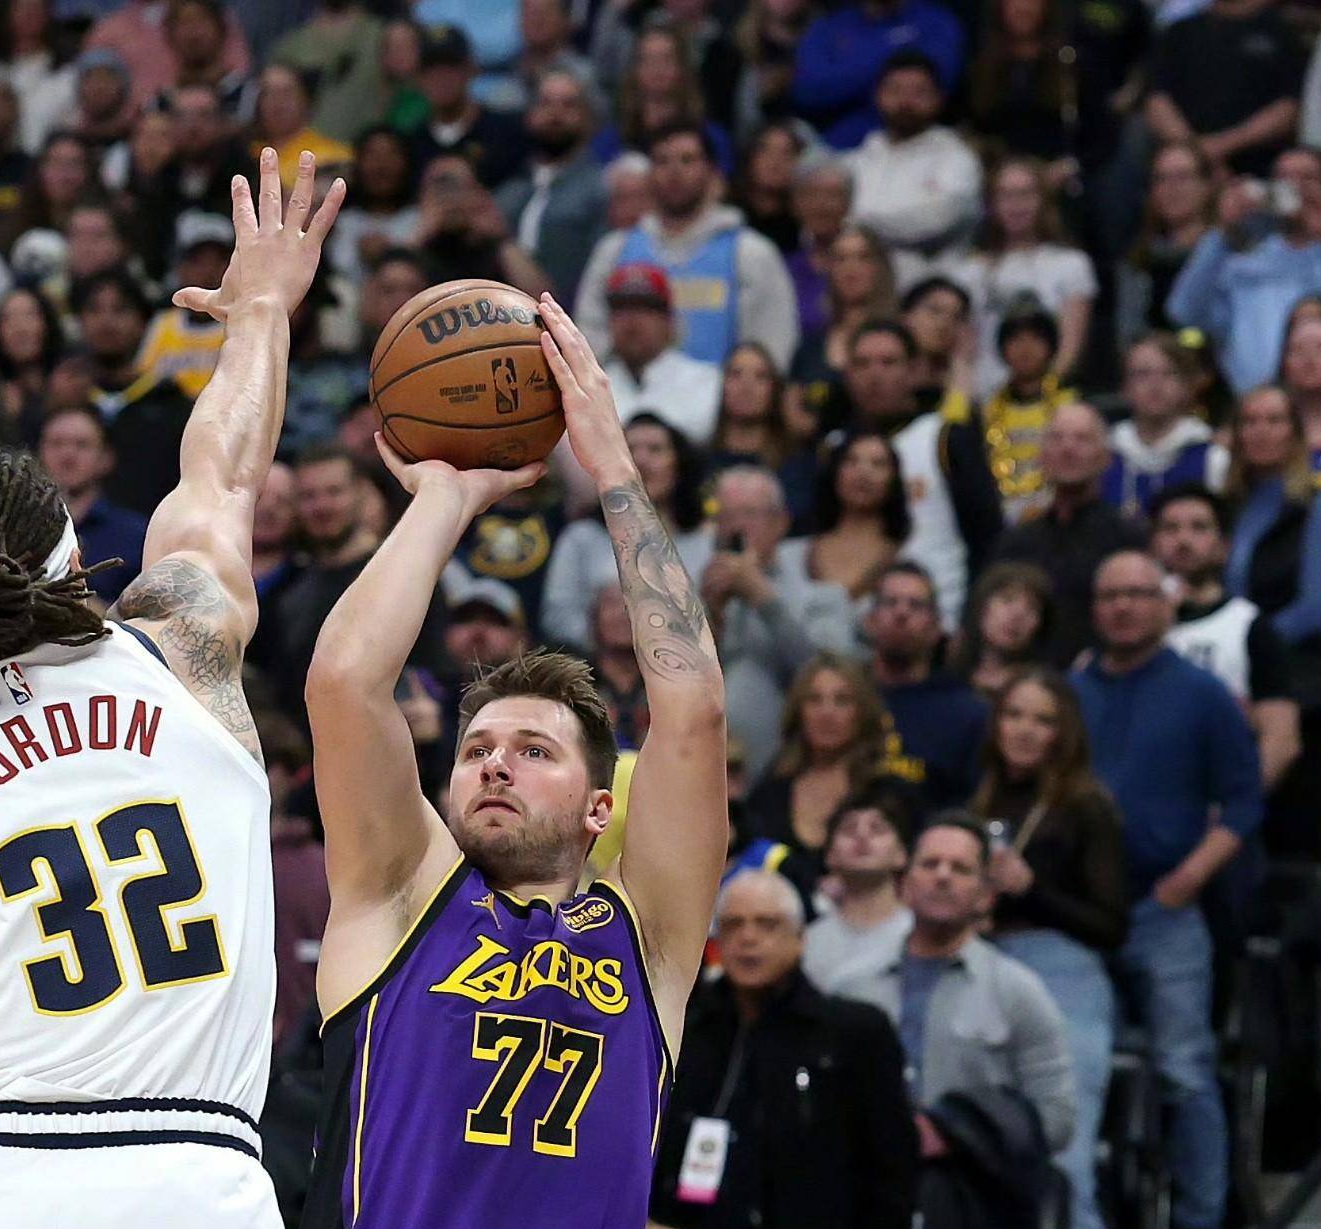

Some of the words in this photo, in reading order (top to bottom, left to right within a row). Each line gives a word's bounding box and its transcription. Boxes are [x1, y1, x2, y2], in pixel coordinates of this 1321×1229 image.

[417, 299, 545, 344] Wilso
[429, 934, 629, 1015] LAKERS
[464, 1011, 605, 1158] 77
